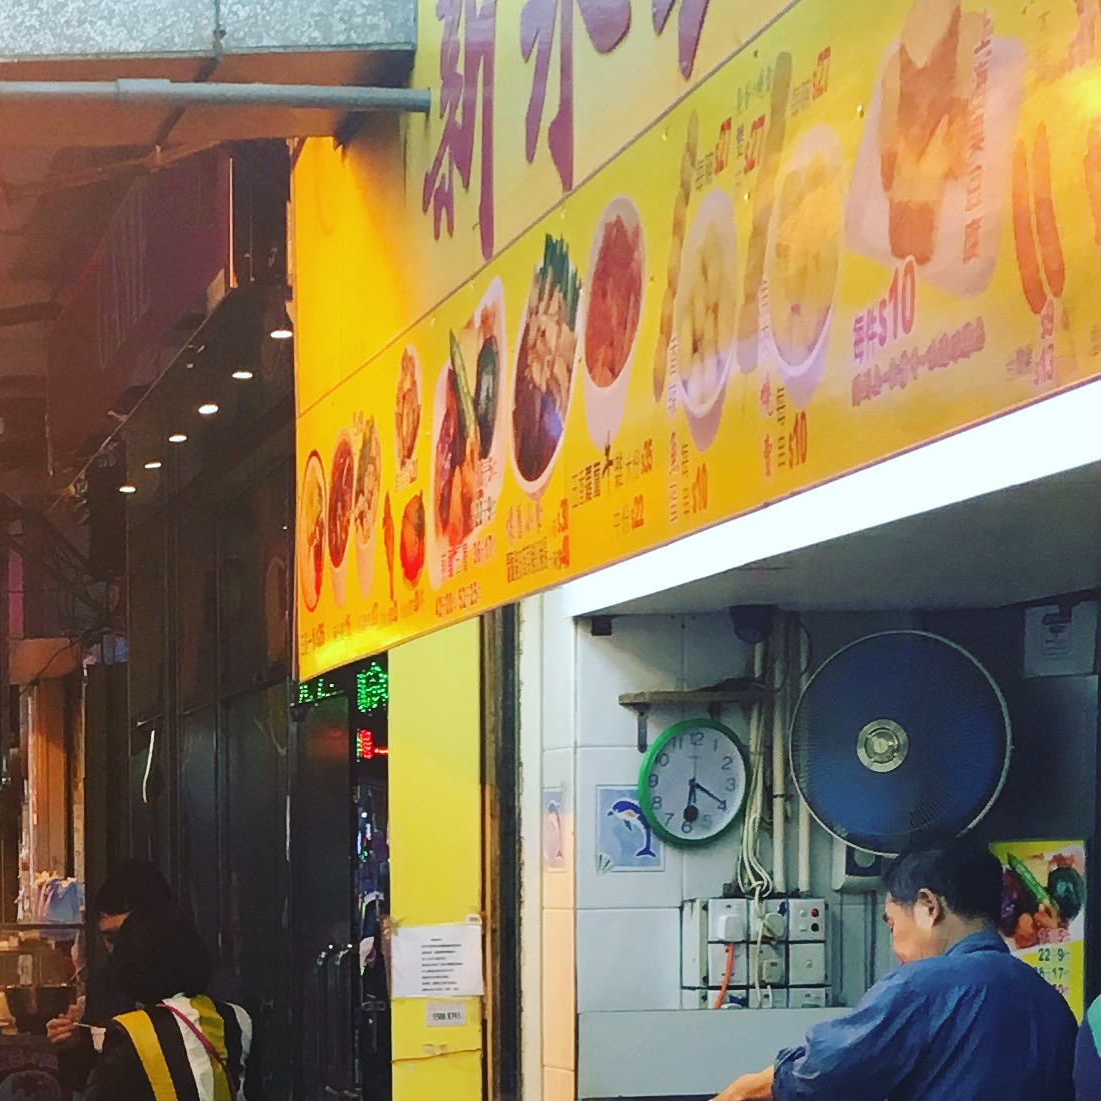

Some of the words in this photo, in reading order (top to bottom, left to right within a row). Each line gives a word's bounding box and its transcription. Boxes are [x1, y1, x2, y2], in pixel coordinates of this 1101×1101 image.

[721, 756, 733, 770] 2
[649, 774, 659, 788] 9
[725, 778, 736, 792] 3
[652, 796, 662, 810] 8
